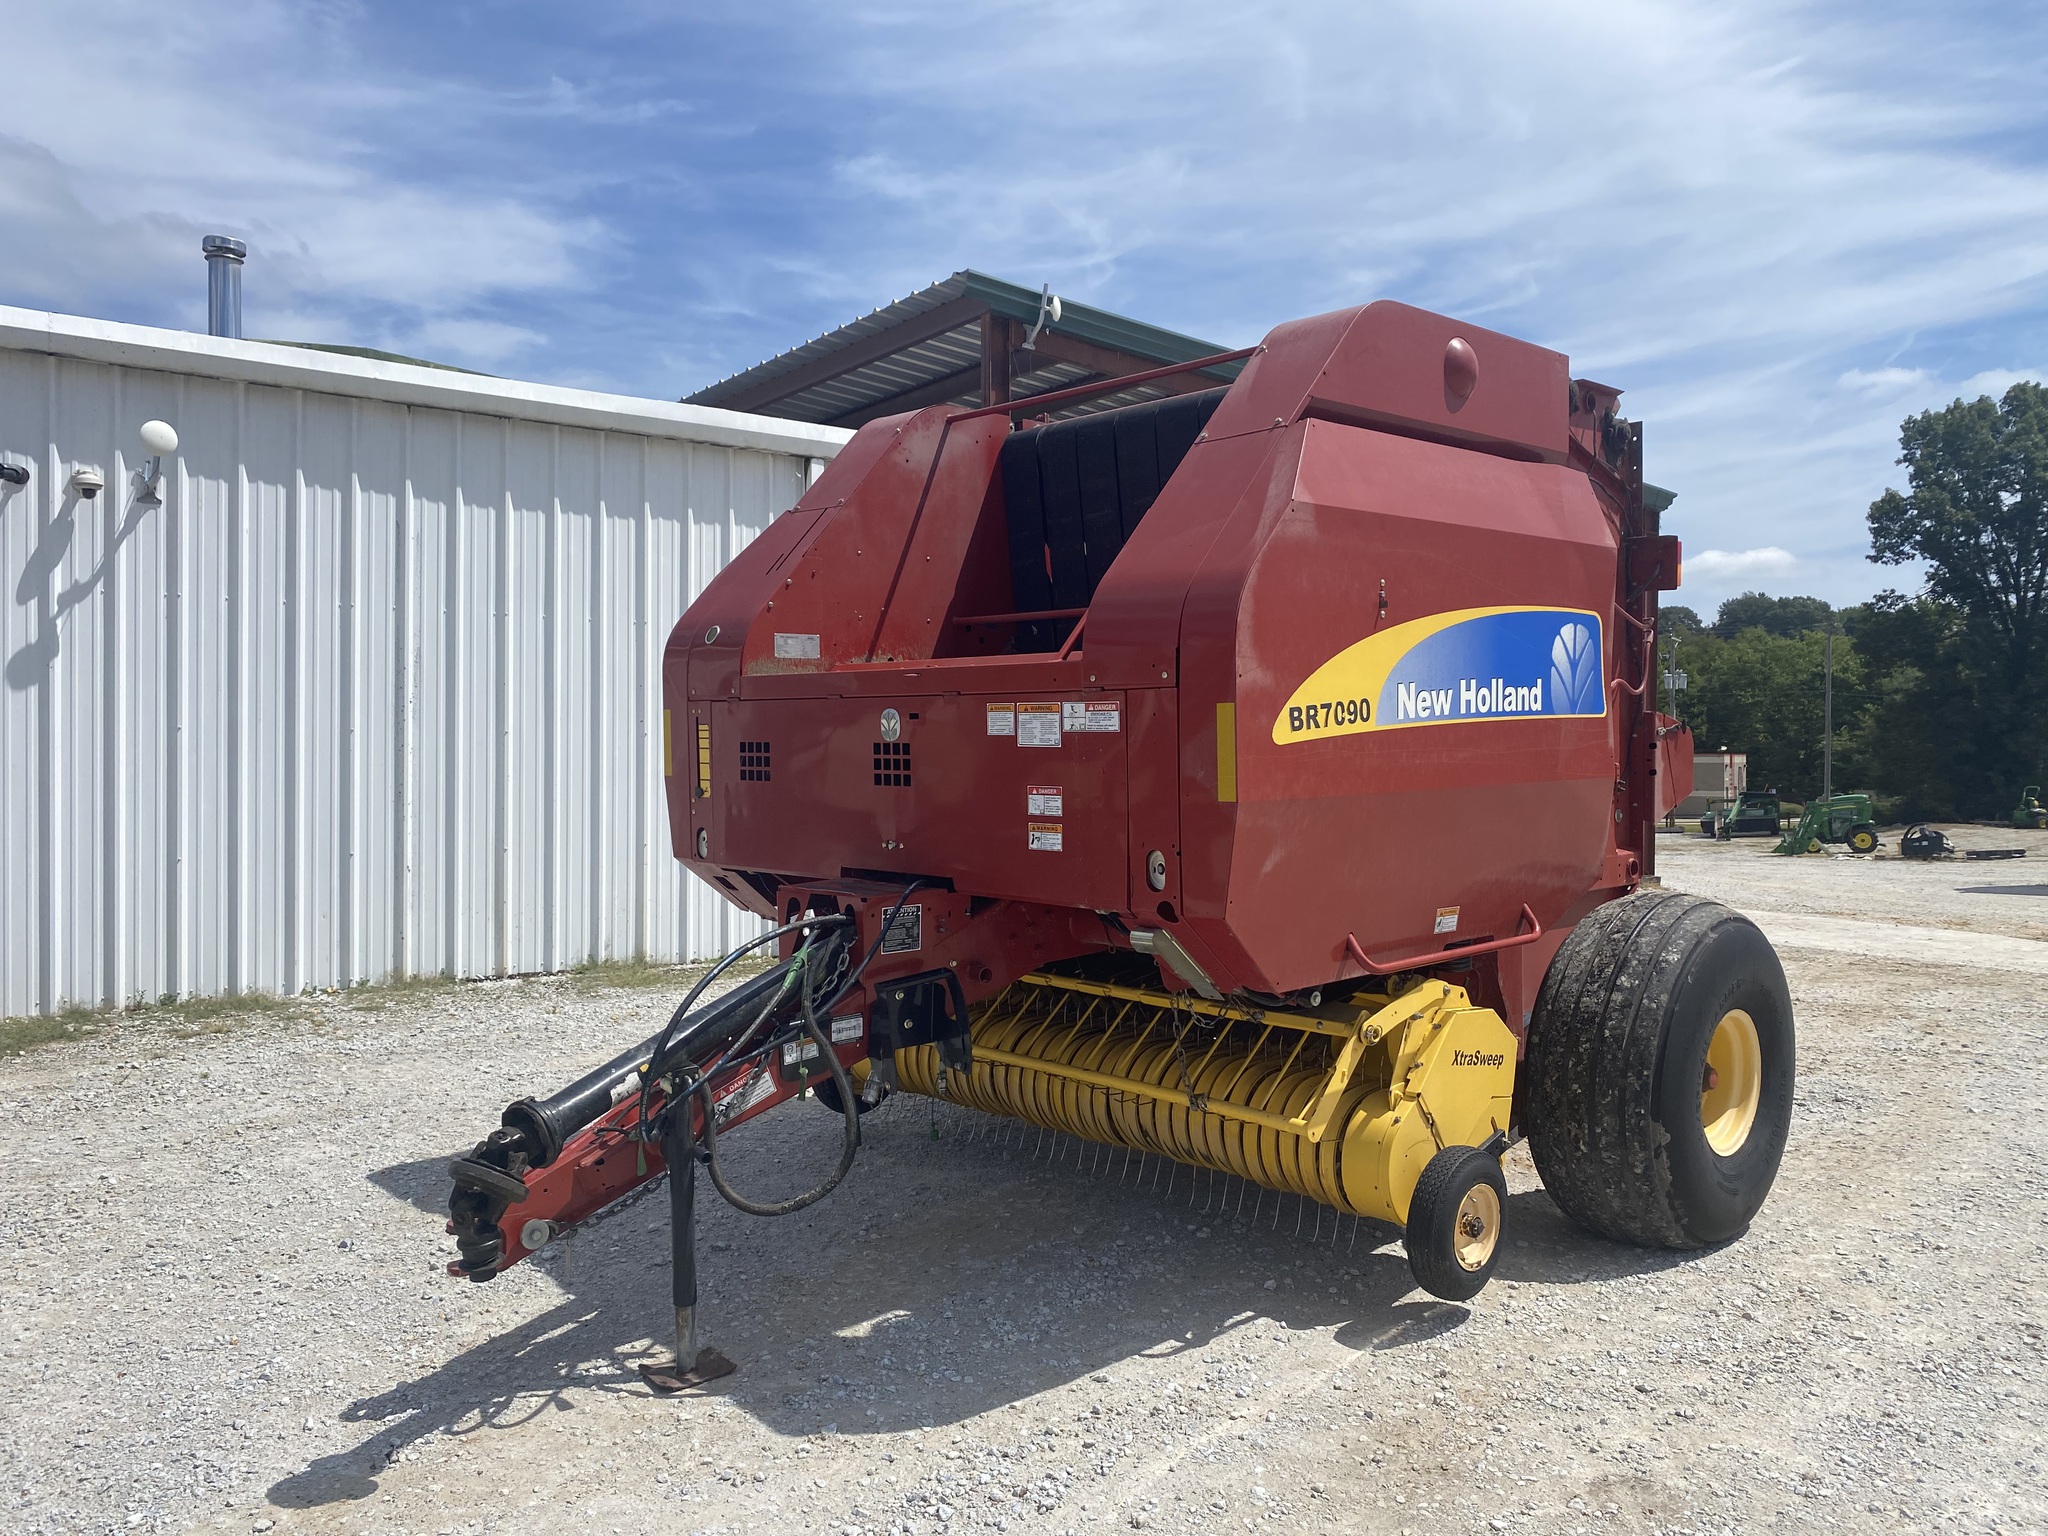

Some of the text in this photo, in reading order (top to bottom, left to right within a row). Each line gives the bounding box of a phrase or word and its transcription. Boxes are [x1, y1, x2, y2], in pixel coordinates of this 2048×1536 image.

[1289, 698, 1371, 733] BR7090
[1396, 677, 1543, 720] New Holland
[1451, 1049, 1504, 1070] XtraSweep
